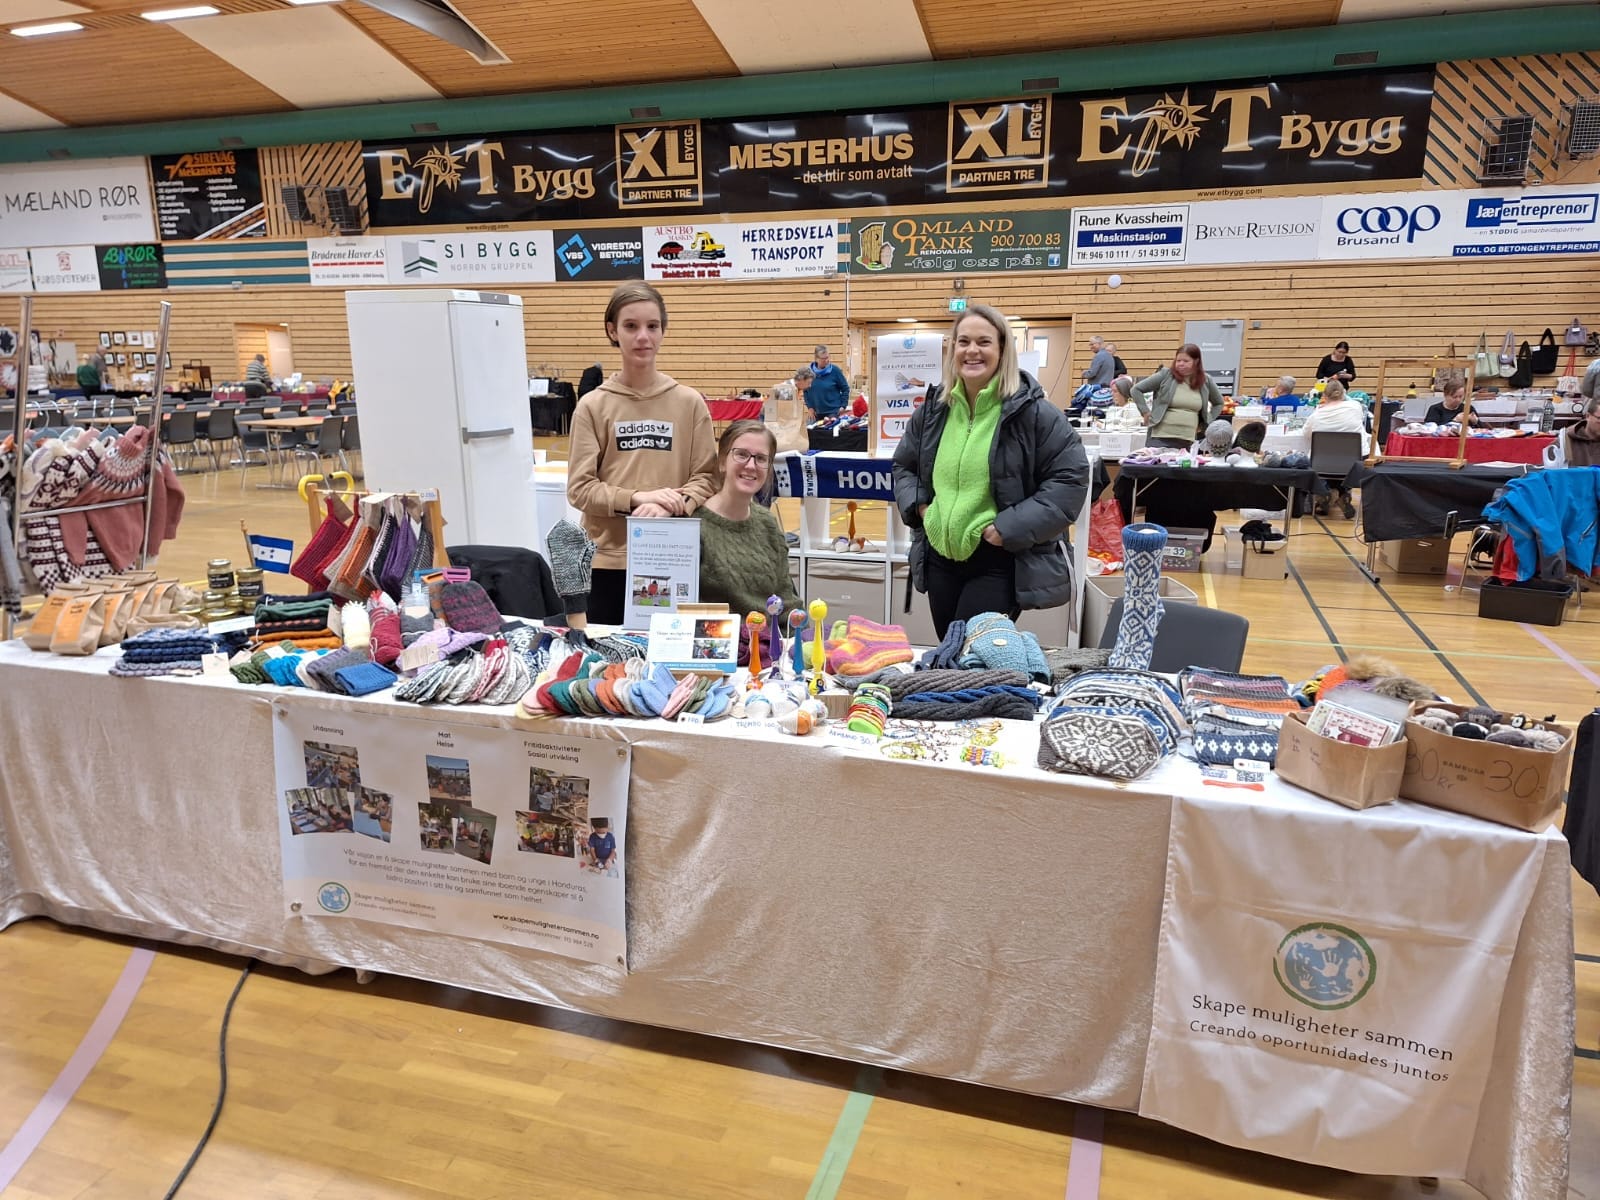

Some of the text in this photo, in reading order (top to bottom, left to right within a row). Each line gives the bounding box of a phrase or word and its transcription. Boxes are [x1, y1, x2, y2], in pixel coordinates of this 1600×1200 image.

[1030, 103, 1043, 139] BYGG
[954, 105, 1041, 159] XL
[1279, 114, 1404, 157] Bygg
[684, 128, 695, 161] BYGG
[729, 133, 914, 169] MESTERHUS
[623, 130, 695, 179] XL
[224, 164, 236, 175] AS
[803, 165, 913, 183] det blir som avtalt
[960, 169, 1035, 183] PARTNER TRE
[512, 165, 596, 200] Bygg
[5, 185, 140, 212] MÆLAND RØR
[629, 188, 692, 200] PARTNER TRE
[1079, 211, 1183, 227] Rune Kvassheim
[1337, 204, 1441, 243] coop
[742, 225, 834, 243] HERREDSVELA
[892, 219, 1014, 240] OMLAND
[1093, 231, 1167, 243] Maskinstasjon
[591, 241, 642, 252] VIGRESTAD
[900, 235, 974, 257] TANK
[991, 234, 1015, 247] 900
[1018, 233, 1042, 246] 700
[1045, 233, 1061, 245] 83
[1337, 234, 1400, 246] Brusand
[373, 248, 385, 259] AS
[477, 241, 537, 258] BYGG
[565, 252, 583, 260] VBS
[599, 250, 635, 259] BETONG
[751, 246, 824, 261] TRANSPORT
[1089, 251, 1103, 260] 946
[1105, 250, 1114, 259] 10
[1116, 250, 1129, 259] 111
[1138, 249, 1147, 258] 51
[1149, 249, 1159, 257] 43
[1160, 249, 1169, 257] 91
[1171, 248, 1181, 256] 62
[1455, 247, 1483, 255] TOTAL
[1484, 246, 1497, 254] OG
[491, 261, 534, 271] GRUPPEN
[962, 256, 1000, 267] oss
[887, 399, 909, 408] VISA
[618, 423, 656, 434] adidas
[620, 437, 655, 448] adidas
[1173, 548, 1185, 556] 32
[1192, 995, 1454, 1062] Skape muligheter sammen
[1189, 1020, 1450, 1083] Creando oportunidades juntos
